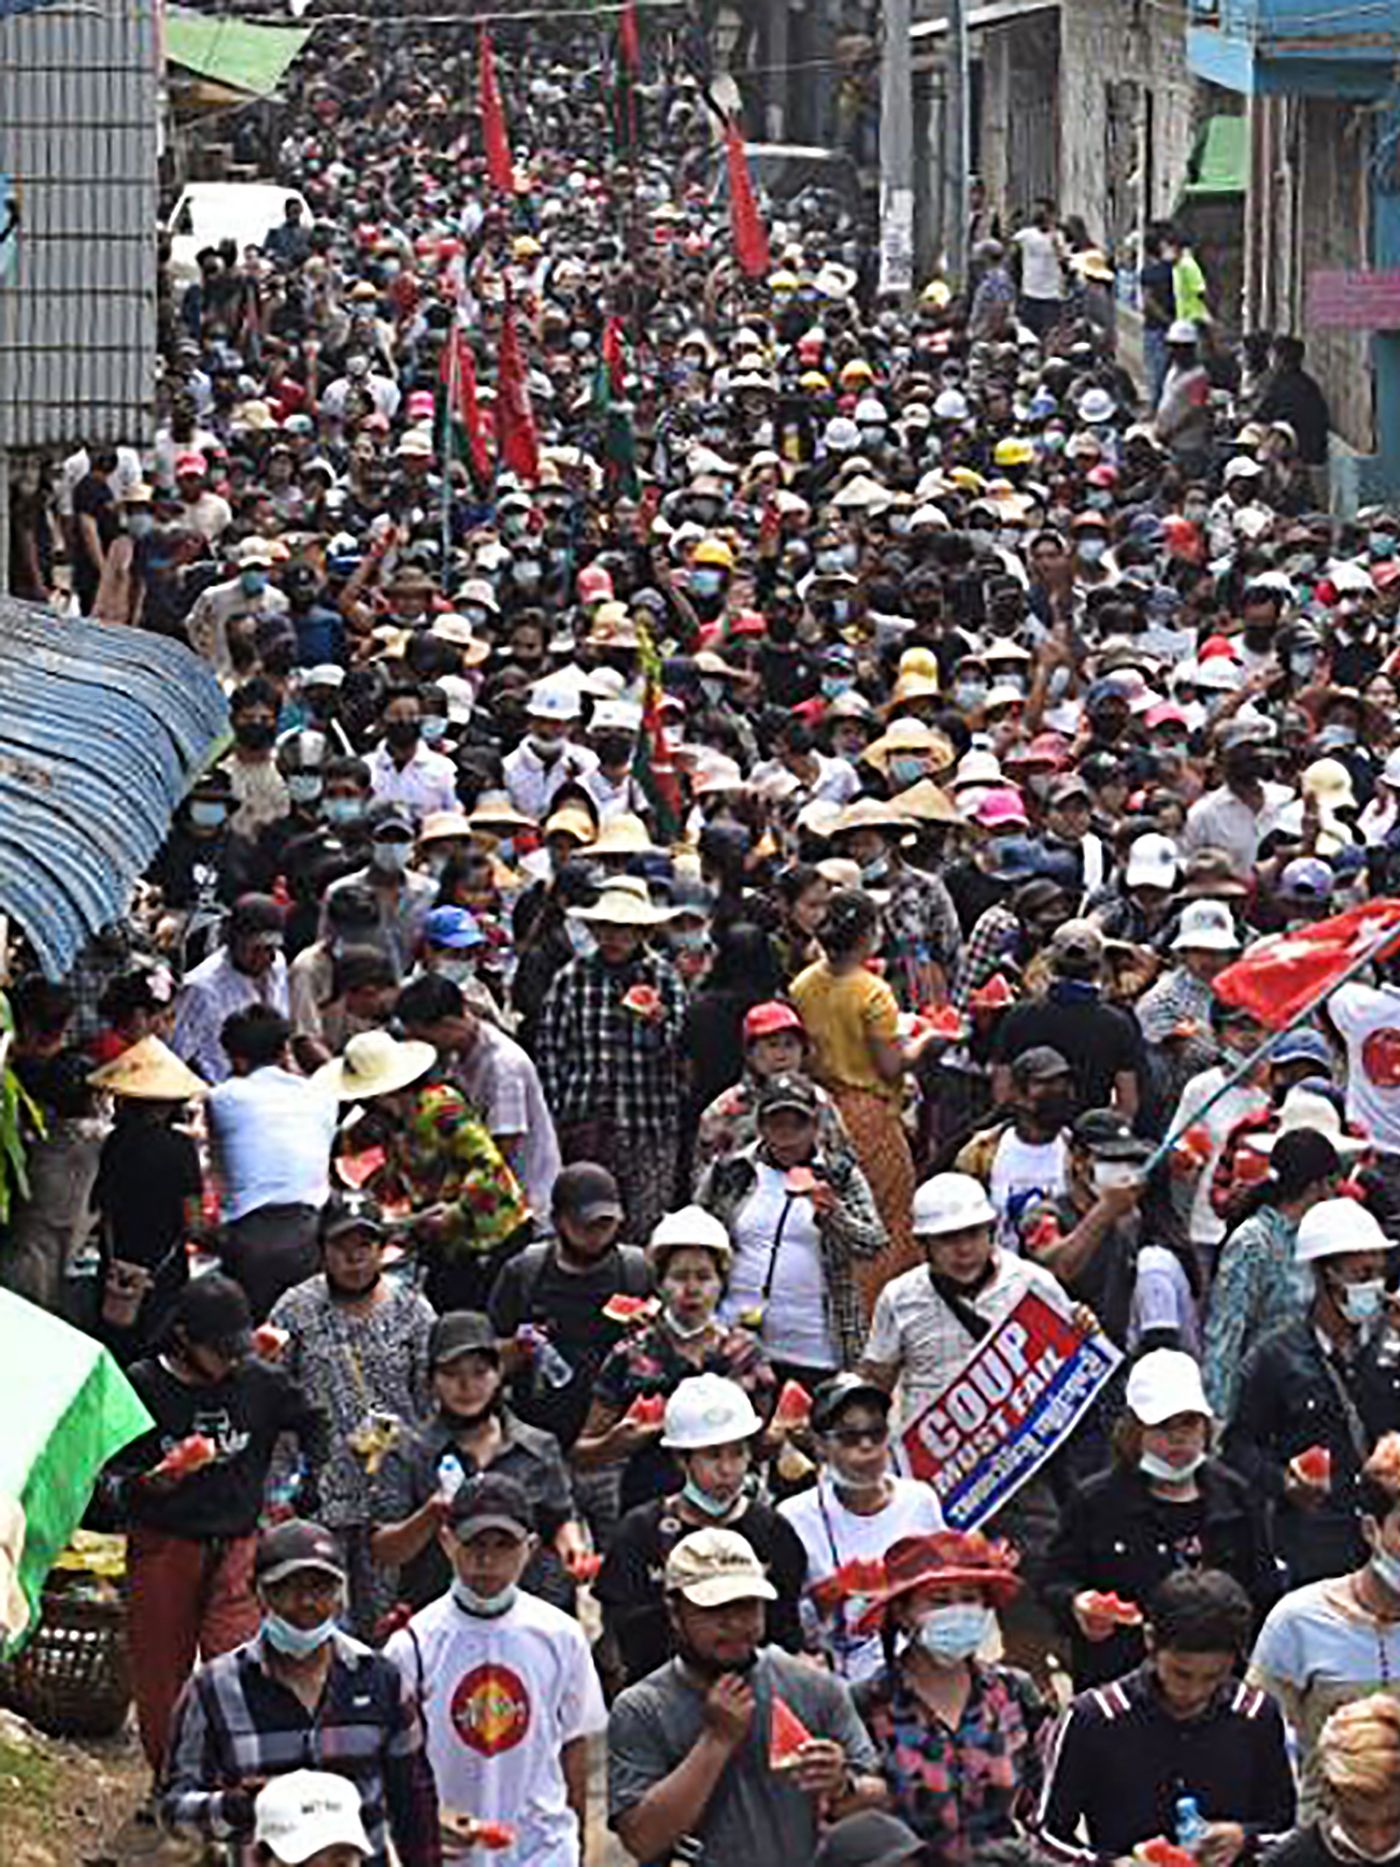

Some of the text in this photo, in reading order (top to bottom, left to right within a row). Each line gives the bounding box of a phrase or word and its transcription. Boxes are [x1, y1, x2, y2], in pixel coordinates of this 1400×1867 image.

[918, 1321, 1029, 1458] COUP
[931, 1411, 1010, 1495] MUST
[1009, 1345, 1065, 1416] FAIL
